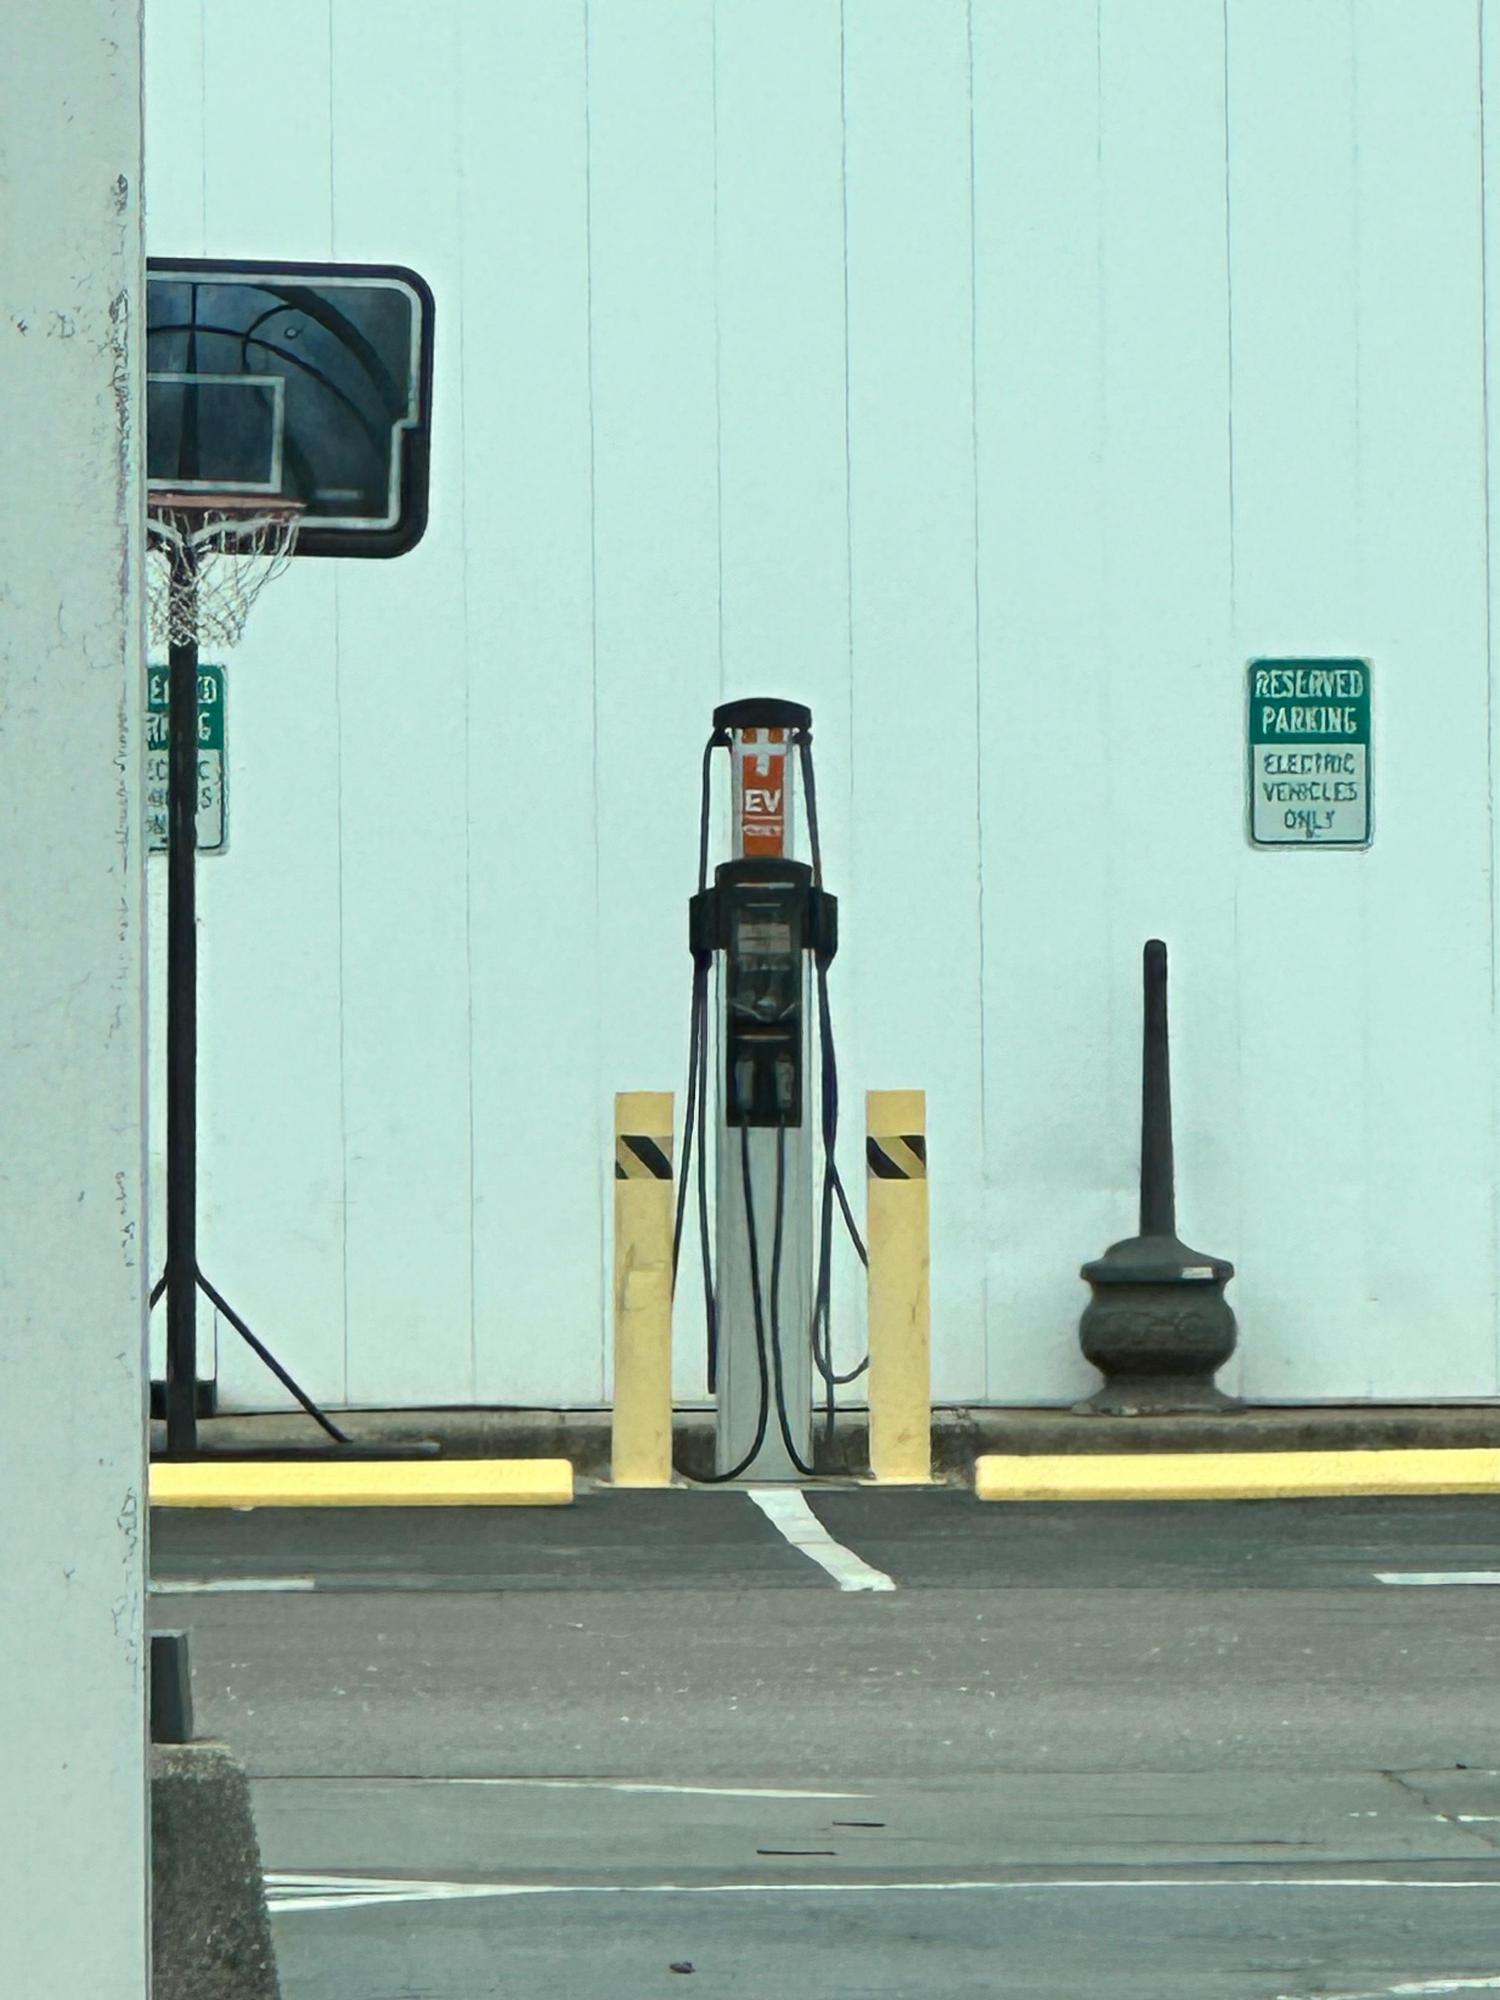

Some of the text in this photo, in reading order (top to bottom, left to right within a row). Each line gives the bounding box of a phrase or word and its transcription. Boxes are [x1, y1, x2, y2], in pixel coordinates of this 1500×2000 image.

[1255, 669, 1364, 698] RESERVED
[1262, 706, 1357, 734] PARKING
[1264, 752, 1355, 775] ELECTRIC
[744, 788, 782, 814] EV
[1262, 782, 1358, 802] VEHICLES
[1284, 809, 1335, 829] ONLY
